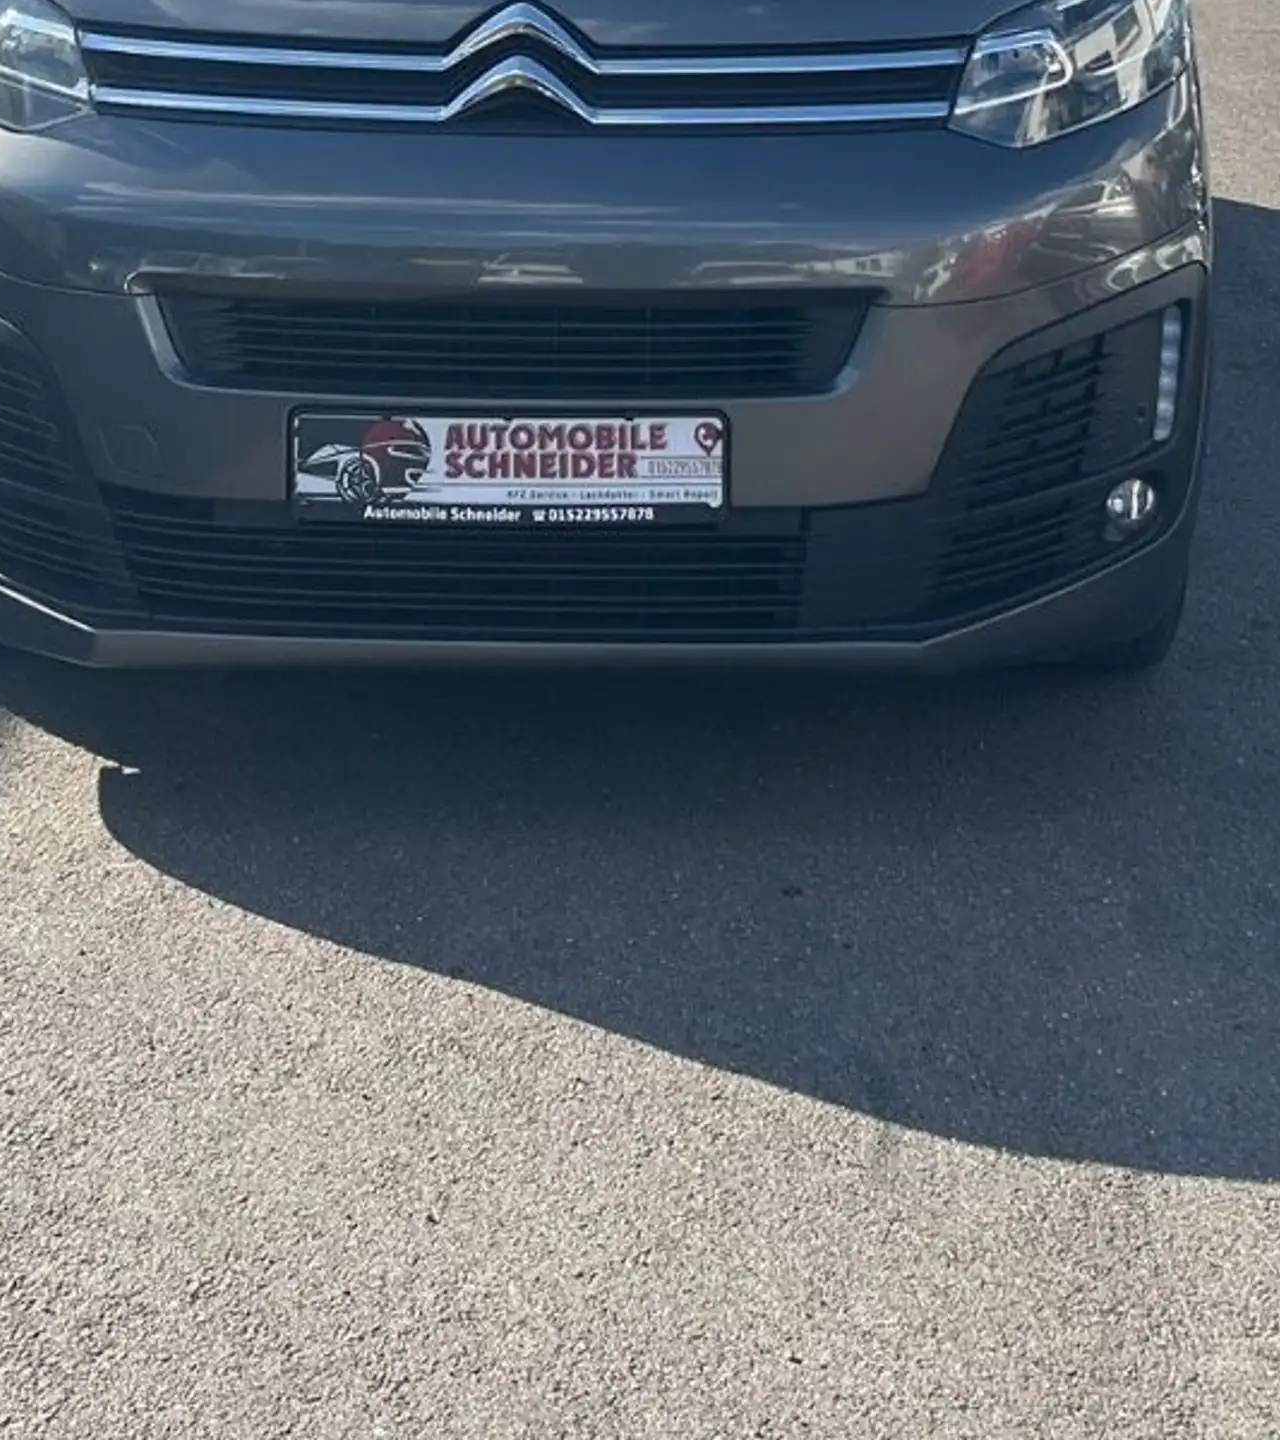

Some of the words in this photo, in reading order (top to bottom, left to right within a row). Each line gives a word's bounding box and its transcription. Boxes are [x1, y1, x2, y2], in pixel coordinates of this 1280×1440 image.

[445, 423, 667, 450] AUTOMOBILE
[445, 451, 638, 478] SCHNEIDER
[363, 506, 447, 520] Automobile
[450, 507, 521, 521] Schneider
